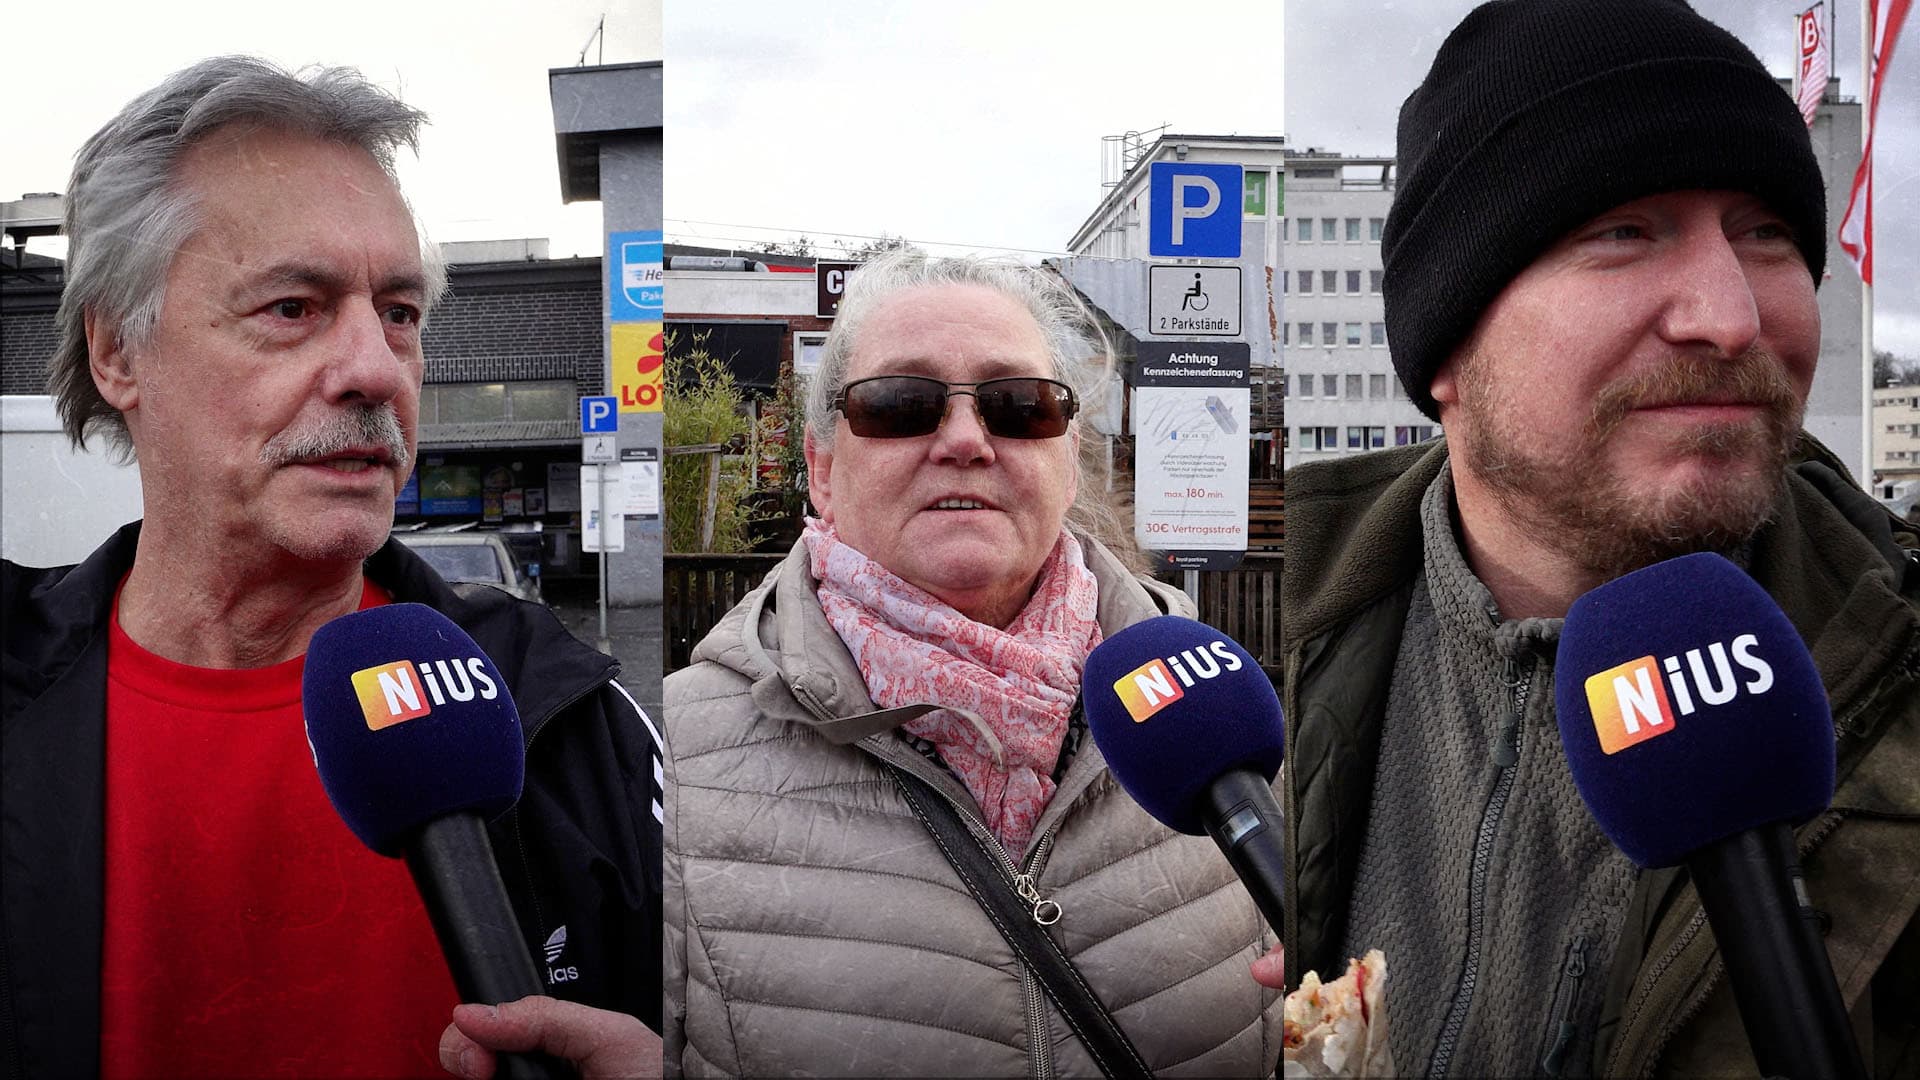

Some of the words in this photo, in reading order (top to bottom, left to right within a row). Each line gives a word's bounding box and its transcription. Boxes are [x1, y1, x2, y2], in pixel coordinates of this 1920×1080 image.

[1171, 175, 1221, 245] P
[1160, 317, 1167, 330] 2
[1171, 317, 1230, 331] Parkstände
[1168, 353, 1219, 367] Achtung
[1143, 367, 1244, 380] Kennzeichenerfassung
[589, 401, 610, 429] P
[1164, 490, 1185, 498] max.
[1186, 488, 1206, 498] 180
[1207, 490, 1224, 498] min.
[1145, 523, 1169, 533] 30€
[1172, 525, 1241, 535] Vertragsstrafe
[548, 966, 579, 984] as
